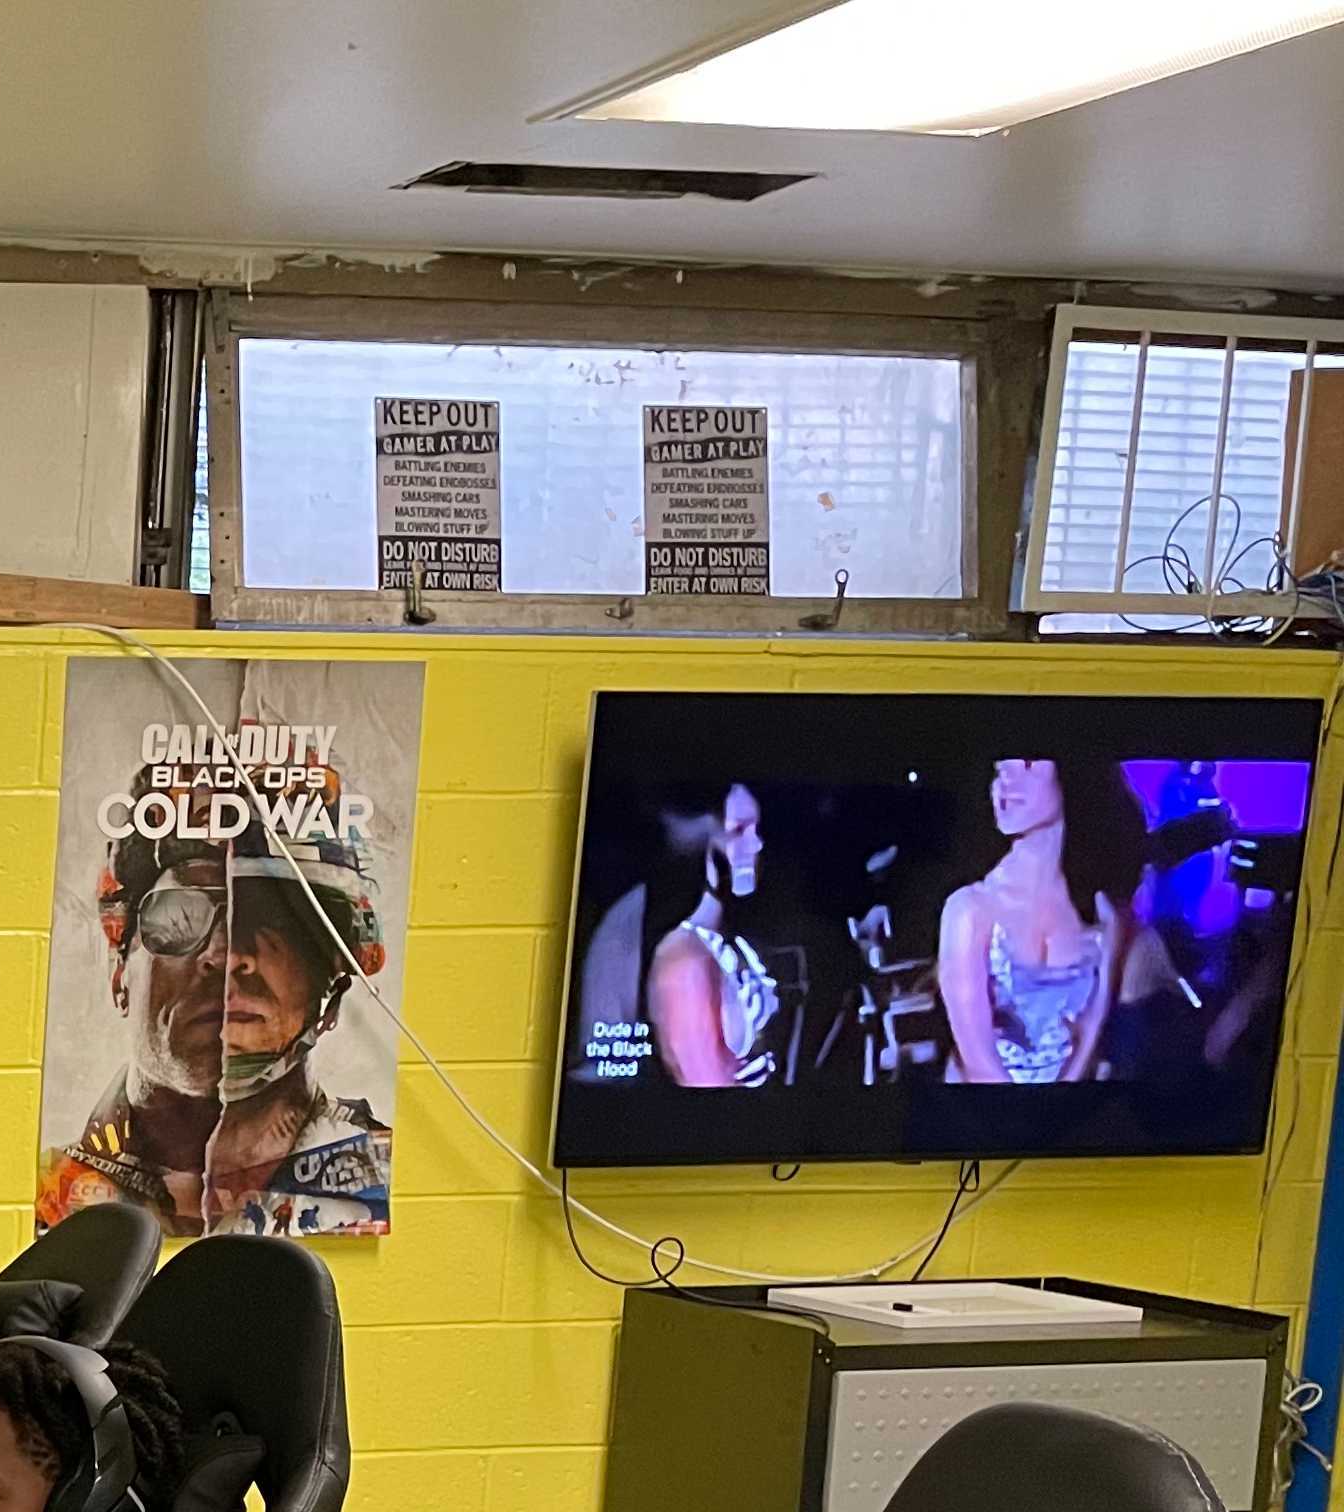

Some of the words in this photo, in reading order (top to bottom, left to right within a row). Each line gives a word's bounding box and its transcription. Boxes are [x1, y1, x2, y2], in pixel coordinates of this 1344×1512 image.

[383, 400, 441, 426] KEEP
[447, 402, 492, 429] OUT
[651, 409, 709, 433] KEEP
[714, 410, 761, 434] OUT
[383, 436, 435, 454] GAMER
[440, 435, 458, 452] AT
[462, 434, 497, 451] PLAY
[651, 444, 702, 461] GAMER
[707, 442, 724, 458] AT
[729, 440, 765, 457] PLAY
[383, 475, 437, 487] DEFEATING
[401, 491, 452, 503] SMASHING
[455, 493, 480, 504] CARS
[669, 498, 719, 509] SMASHING
[722, 498, 748, 509] CARS
[395, 506, 451, 518] MASTERING
[453, 508, 488, 520] MOVES
[662, 512, 719, 524] MASTERING
[720, 513, 755, 524] MOVES
[395, 521, 440, 534] BLOWING
[443, 523, 472, 534] STUFF
[474, 524, 489, 535] UP
[662, 527, 708, 539] BLOWING
[710, 528, 738, 539] STUFF
[742, 528, 756, 539] UP
[383, 541, 404, 560] DO
[408, 541, 438, 560] NOT
[441, 542, 499, 563] DISTURB
[650, 547, 671, 566] DO
[674, 547, 705, 566] NOT
[708, 547, 768, 567] DISTURB
[383, 571, 417, 588] ENTE
[425, 571, 441, 588] AT
[443, 572, 471, 589] OWN
[473, 573, 500, 590] RISK
[650, 577, 689, 594] ENTER
[692, 577, 707, 593] AT
[709, 577, 739, 594] OWN
[741, 577, 768, 595] RISK
[141, 723, 229, 765] CALL
[239, 724, 338, 765] DUTY
[151, 767, 250, 789] BLACK
[264, 767, 327, 789] OPS
[97, 792, 251, 840] COLD
[260, 793, 375, 840] WAR
[586, 1040, 610, 1058] the
[612, 1040, 653, 1058] Black
[597, 1060, 639, 1077] Hood
